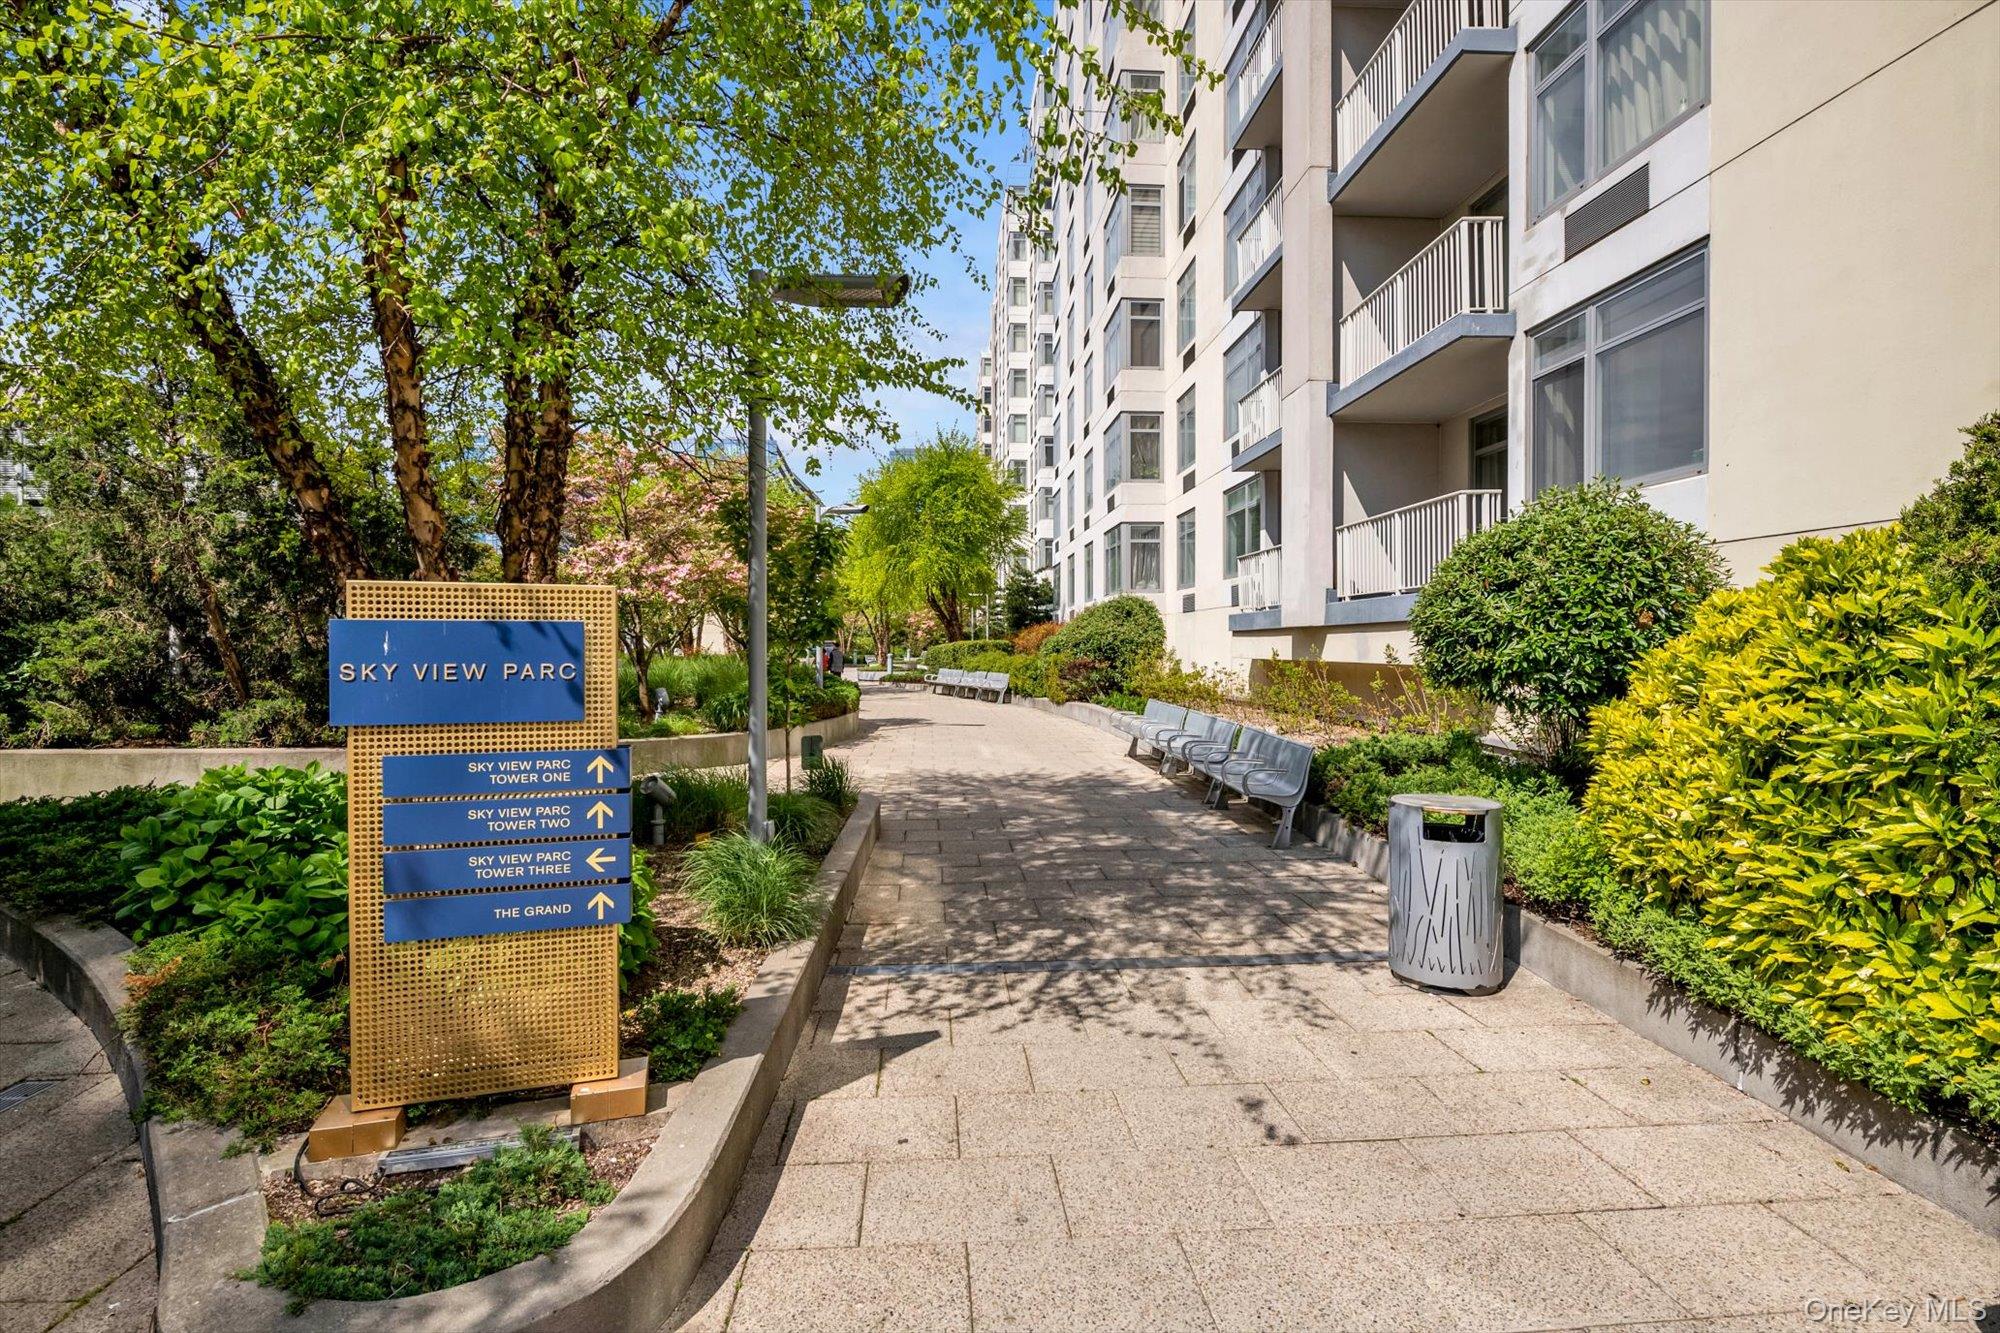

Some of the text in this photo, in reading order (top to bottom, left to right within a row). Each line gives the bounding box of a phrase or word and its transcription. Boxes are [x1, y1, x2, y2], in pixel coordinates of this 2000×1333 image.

[339, 663, 577, 682] SKY VIEW PARC
[468, 759, 571, 772] SKY VIEW PARC
[489, 772, 571, 784] TOWER ONE
[467, 805, 571, 819] SKY VIEW PARC
[487, 818, 571, 831] TOWER TWO
[468, 851, 571, 866] SKY VIEW PARC
[475, 864, 571, 878] TOWER THREE
[494, 904, 571, 919] THE GRAND
